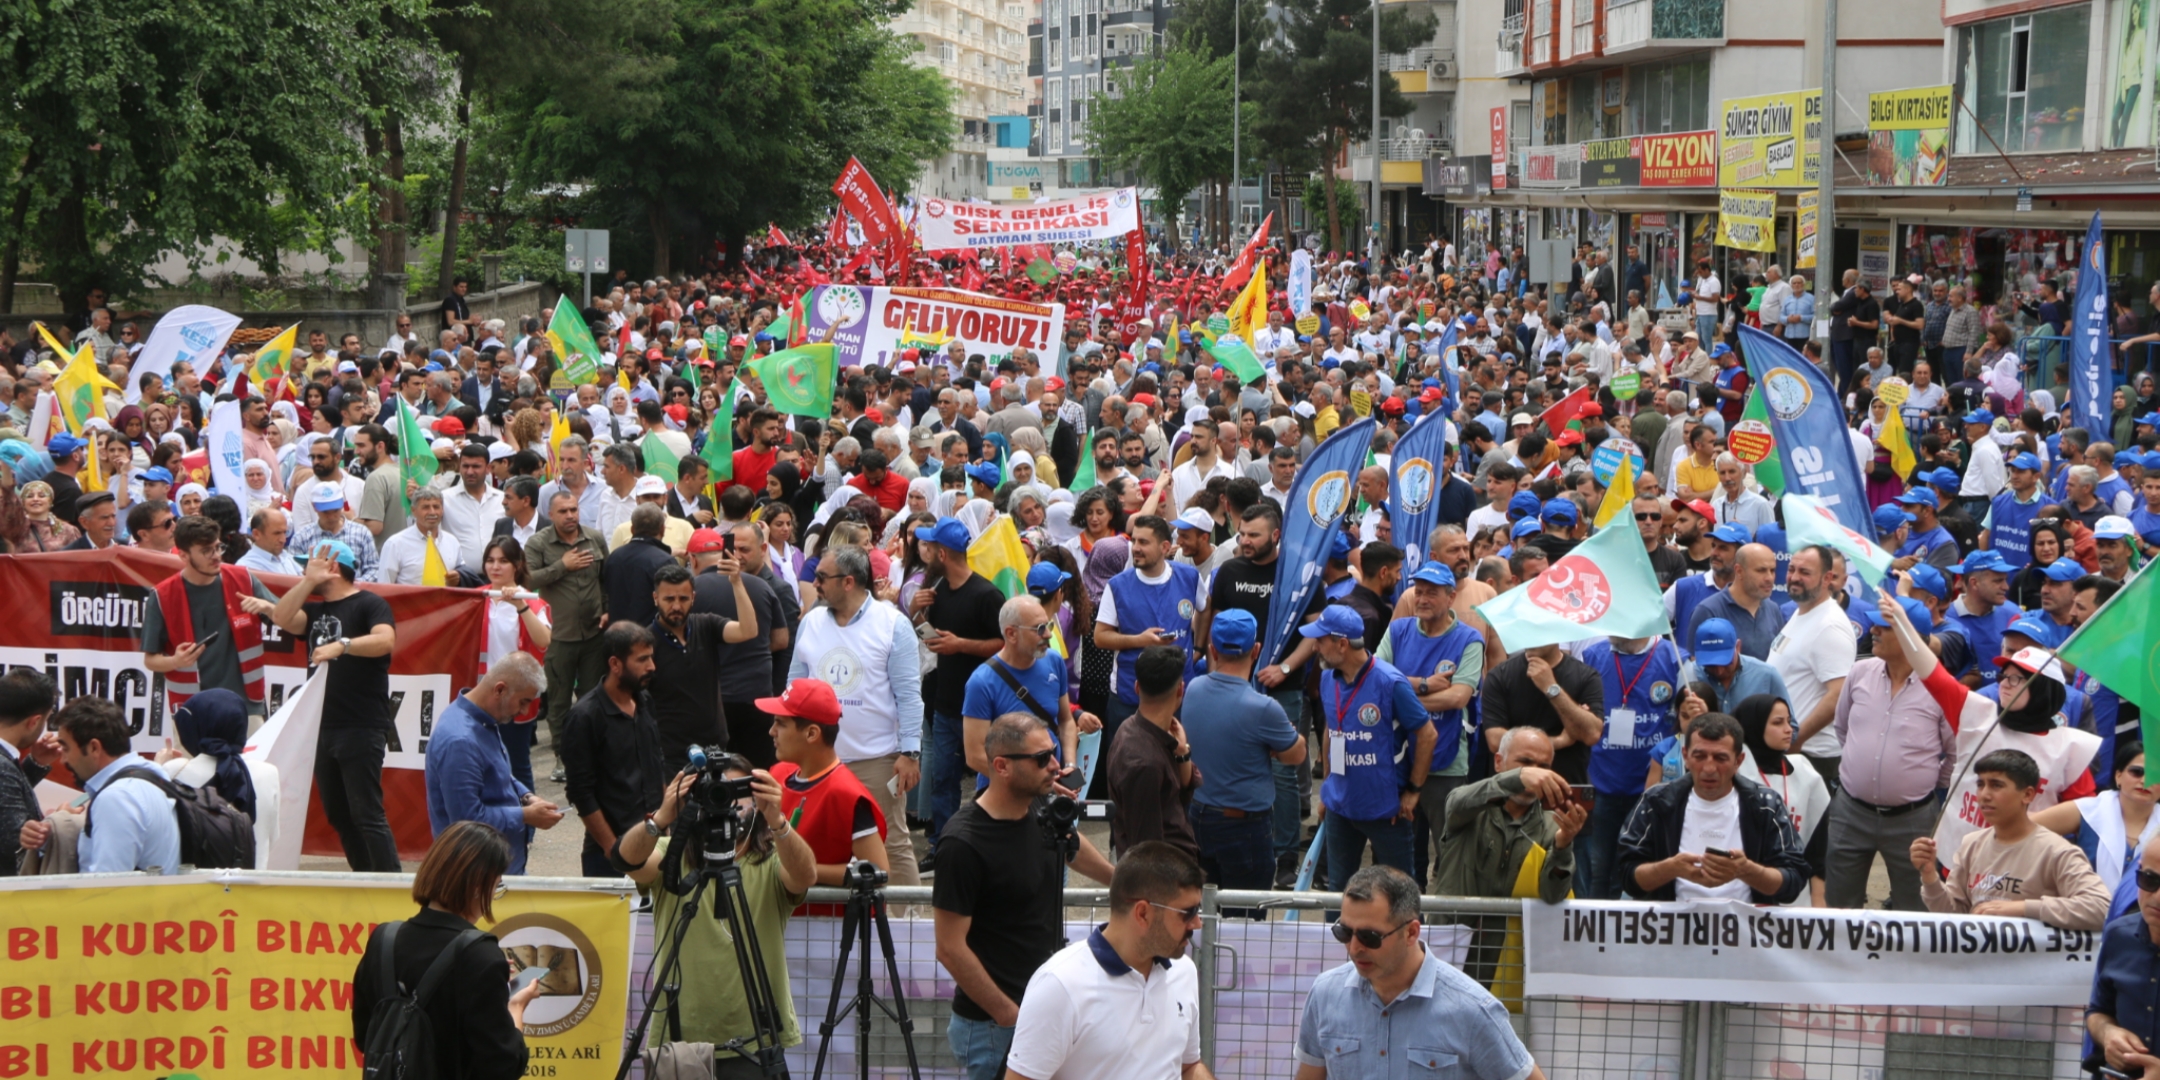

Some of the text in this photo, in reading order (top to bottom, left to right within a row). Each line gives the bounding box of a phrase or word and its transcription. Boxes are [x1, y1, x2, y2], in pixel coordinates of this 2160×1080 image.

[1871, 91, 1949, 122] BİLGİ KIRTASİYE
[1725, 101, 1792, 137] SÜMER GİYİM
[1609, 139, 1631, 160] PERDE
[1768, 144, 1794, 165] BAŞLADI
[1643, 166, 1713, 181] TAŞ ODUN EKMEK FIRINI
[953, 202, 1002, 219] DİSK
[1011, 198, 1109, 220] GENEL-İŞ
[952, 211, 1109, 235] SENDİKASI
[967, 228, 1092, 246] BATMAN ŞUBESİ
[1006, 301, 1036, 314] KURMAK
[1036, 304, 1051, 316] İÇİN
[222, 451, 241, 468] KES
[61, 591, 149, 628] ÖRGÜTL
[1602, 732, 1663, 750] SİKASI
[1968, 871, 2025, 896] LACOSTE
[8, 909, 380, 961] BI KURDÎ BIAX
[1563, 906, 1739, 955] BİRLEŞELİM!
[1751, 912, 1835, 951] KARŞI
[1846, 919, 2037, 960] YOKSULLUĞA
[1, 967, 354, 1020] BI KURDÎ BIXW
[536, 1022, 563, 1036] ZIMAN
[0, 1043, 48, 1079] BI
[73, 1026, 229, 1074] KURDÎ
[528, 1045, 601, 1060] LEYA ARÎ
[523, 1066, 557, 1077] 2018
